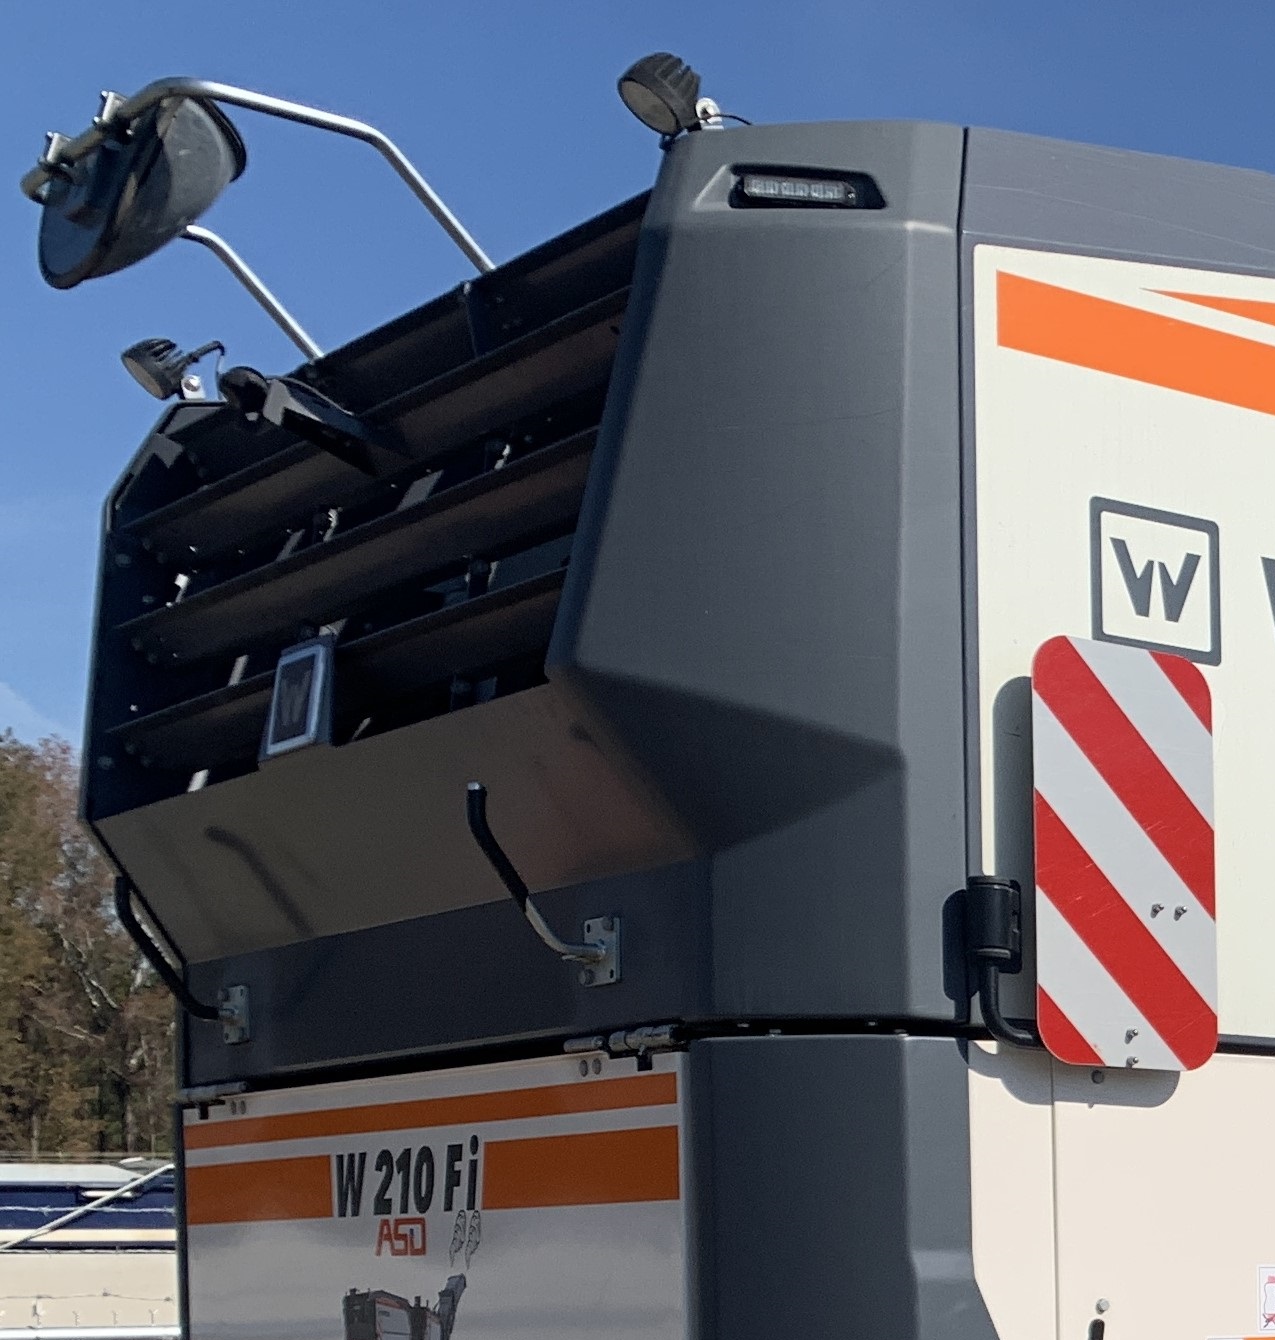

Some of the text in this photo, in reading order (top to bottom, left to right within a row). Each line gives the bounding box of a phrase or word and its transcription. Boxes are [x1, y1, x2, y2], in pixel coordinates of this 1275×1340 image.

[1109, 536, 1201, 622] W
[336, 1134, 479, 1217] W 210 Fi
[375, 1217, 427, 1257] ASD
